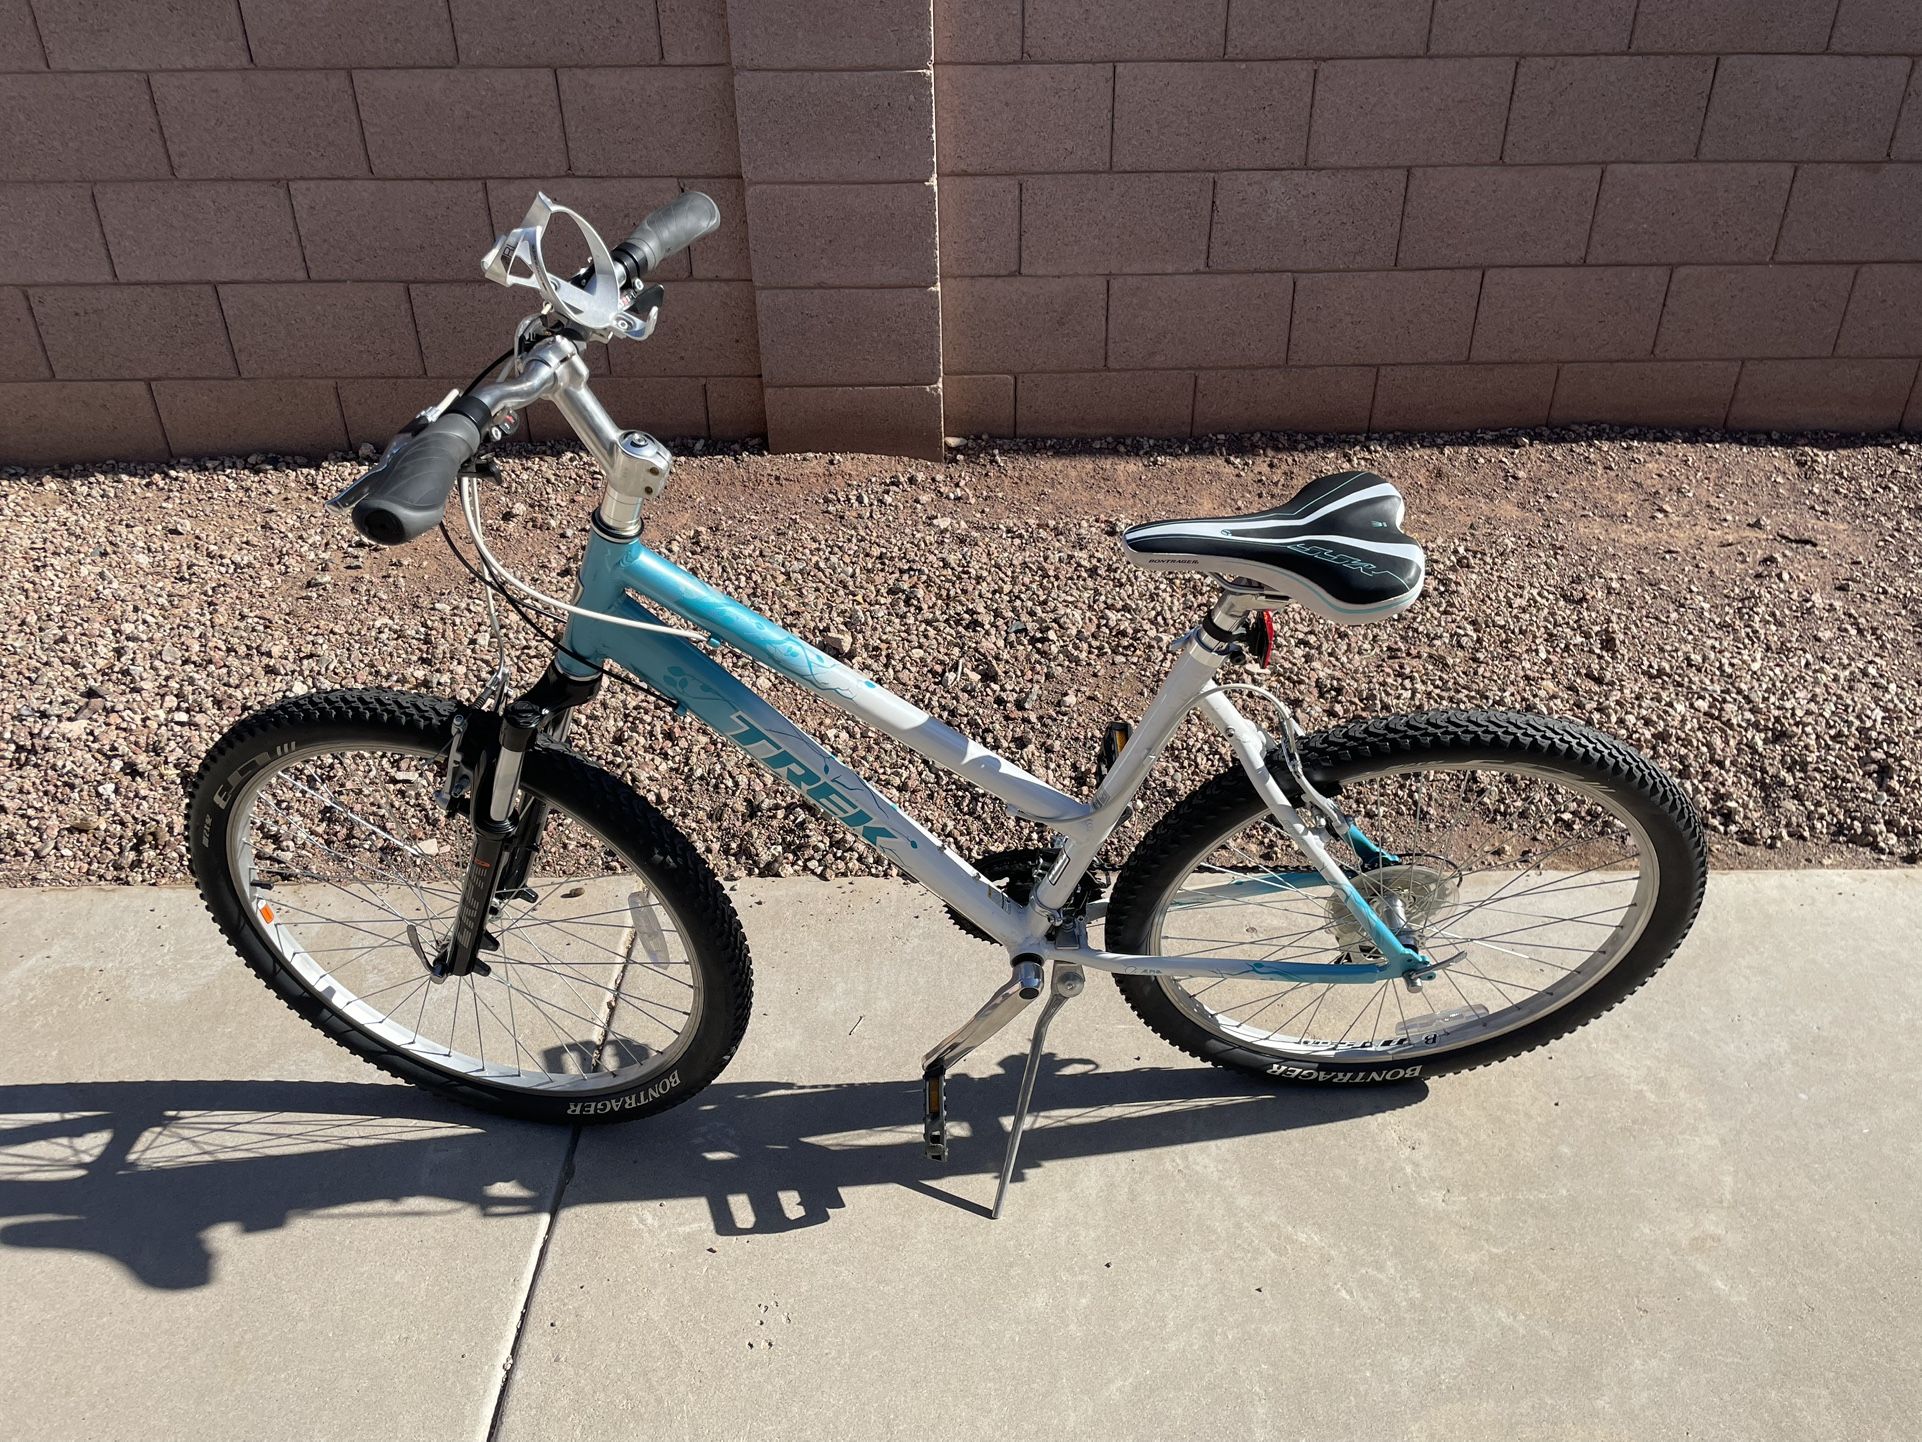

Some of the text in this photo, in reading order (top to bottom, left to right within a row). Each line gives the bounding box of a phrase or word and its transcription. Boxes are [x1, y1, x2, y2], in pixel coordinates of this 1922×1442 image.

[729, 710, 898, 847] TREK
[567, 1069, 681, 1115] BONTRAGER
[1266, 1063, 1423, 1083] BONTRAGER
